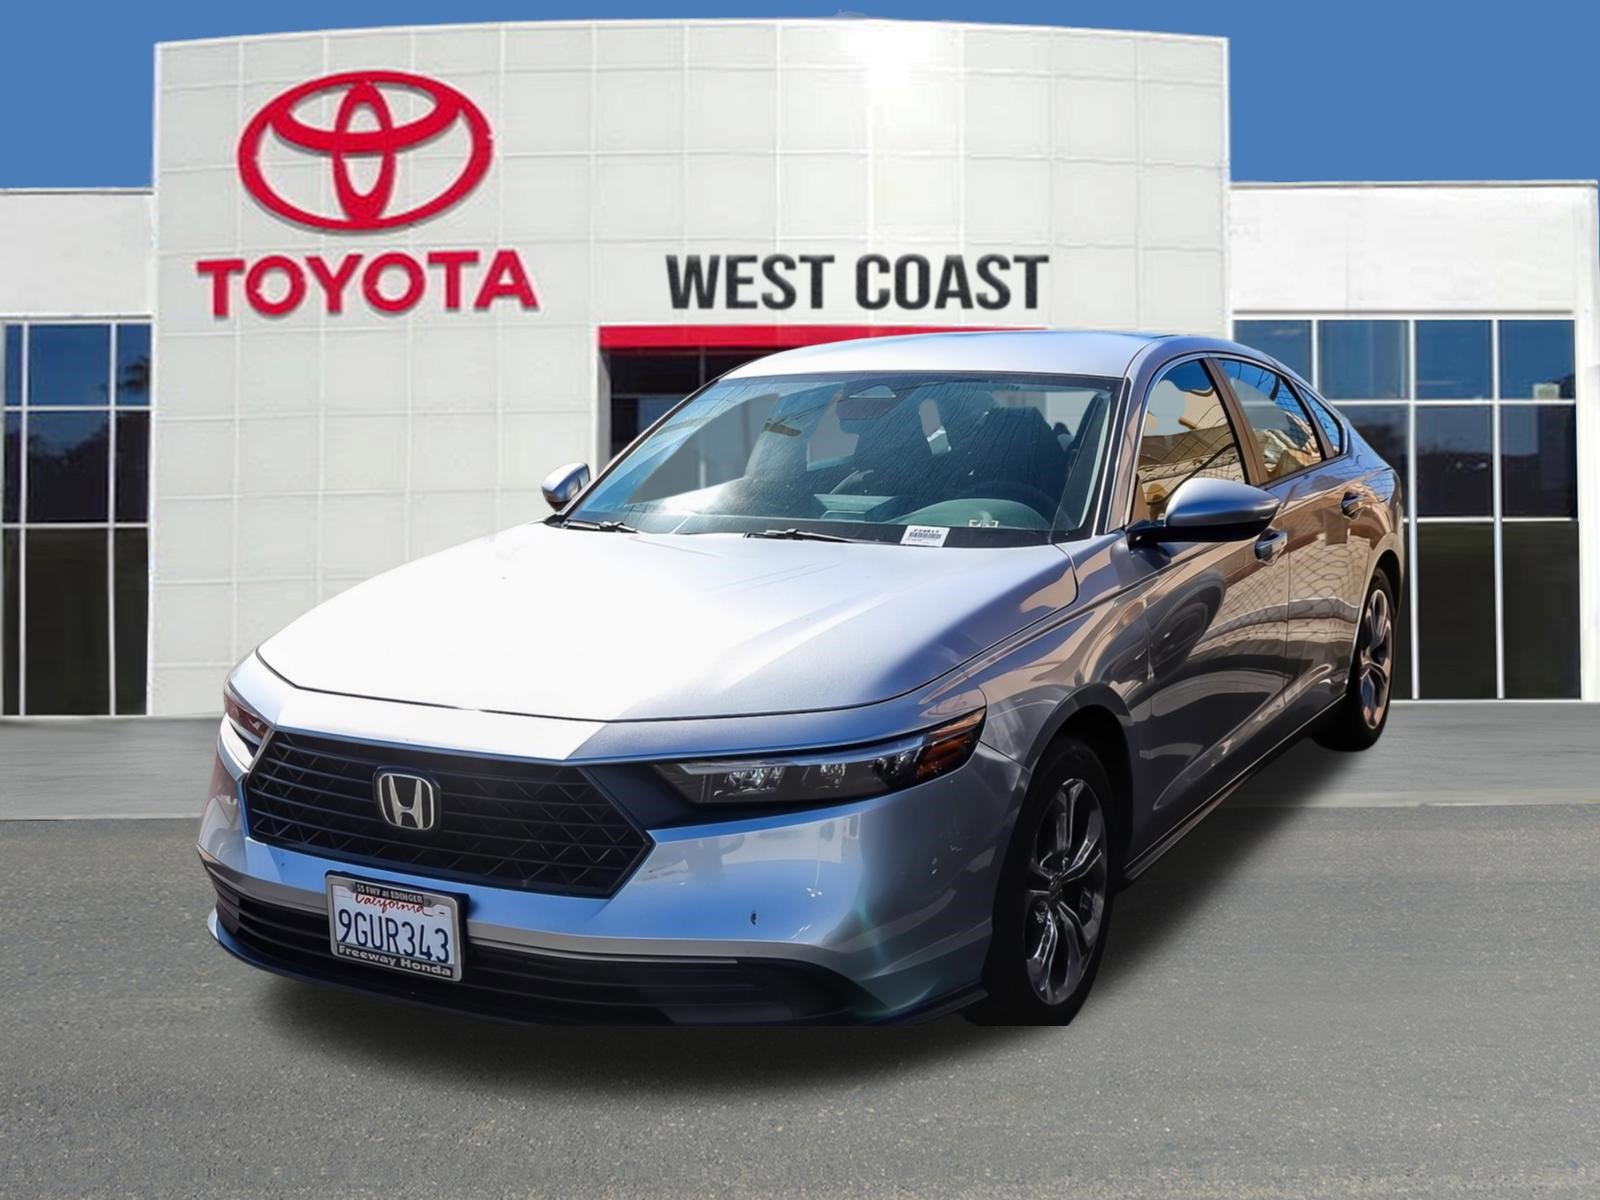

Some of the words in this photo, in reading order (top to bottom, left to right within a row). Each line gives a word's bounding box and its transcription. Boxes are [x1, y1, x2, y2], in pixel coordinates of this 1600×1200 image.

[196, 250, 539, 317] TOYOTA
[665, 254, 835, 310] WEST
[855, 254, 1049, 310] COAST
[355, 894, 430, 917] California
[391, 890, 424, 904] EDINGER
[338, 908, 450, 964] 9GUR343
[338, 944, 397, 967] Freeway
[400, 958, 451, 977] Honda
